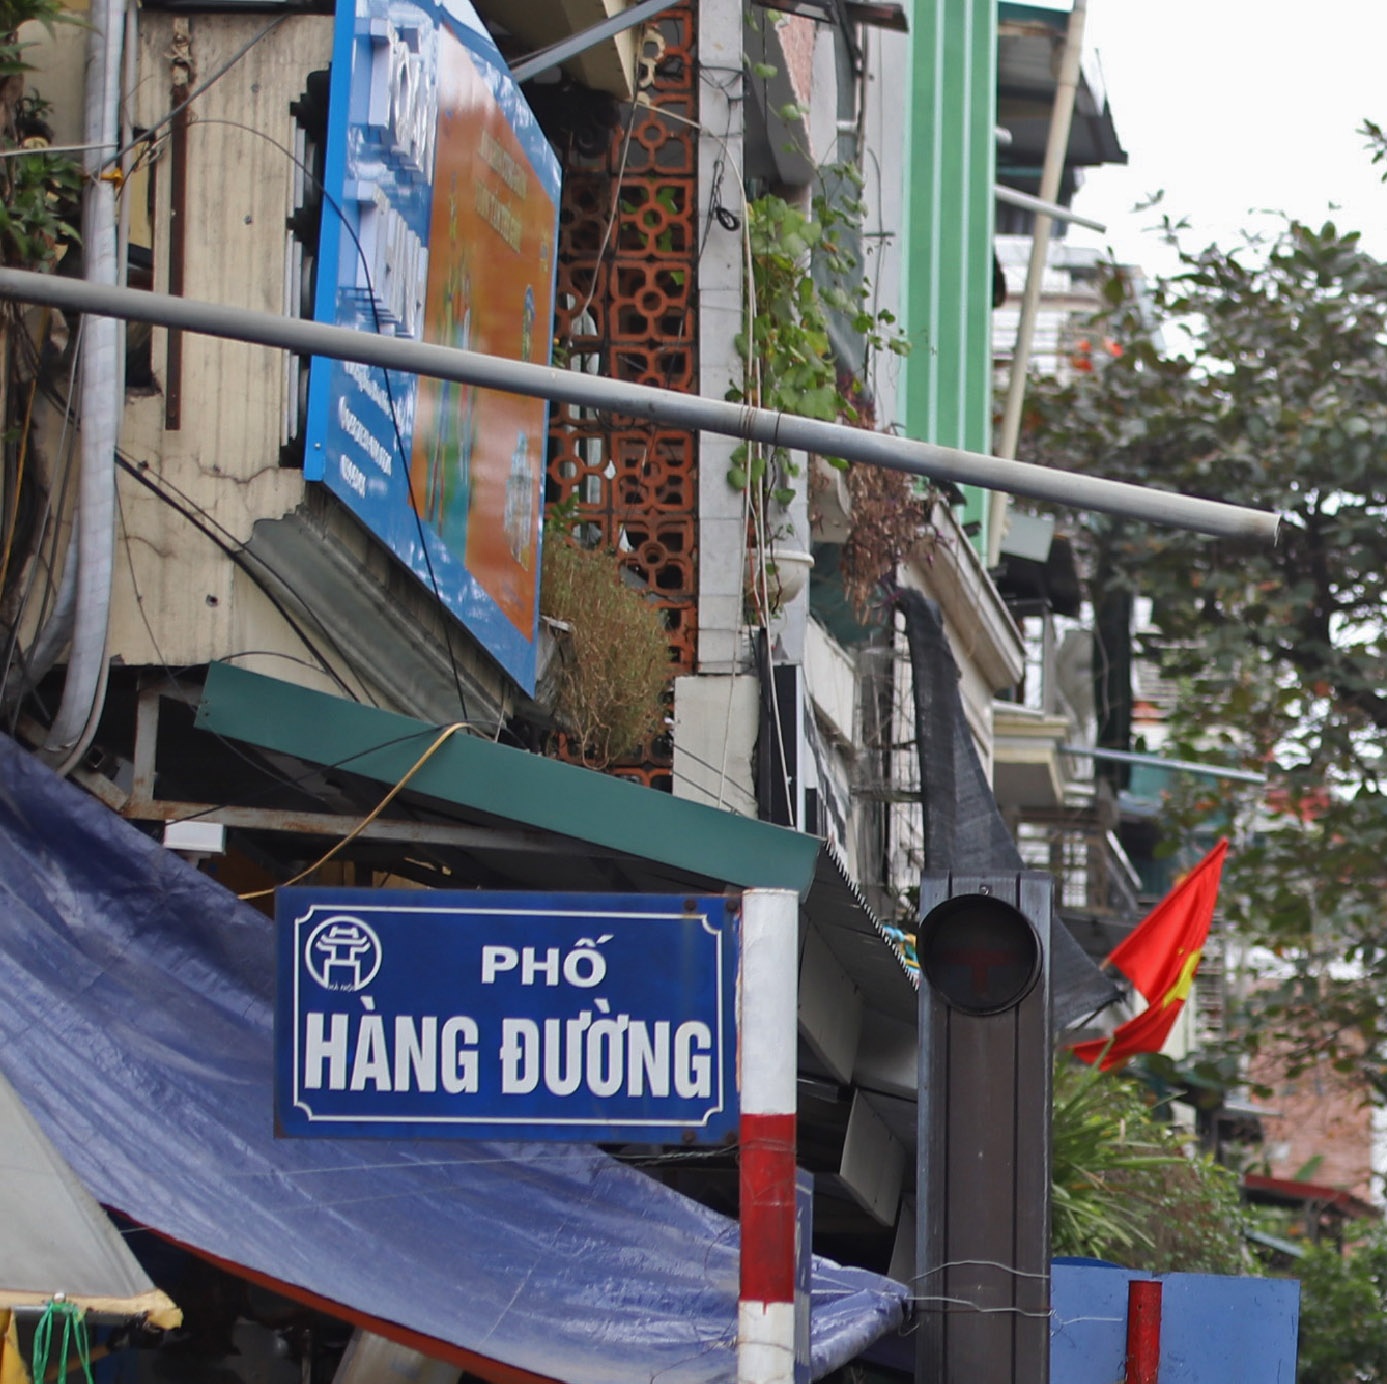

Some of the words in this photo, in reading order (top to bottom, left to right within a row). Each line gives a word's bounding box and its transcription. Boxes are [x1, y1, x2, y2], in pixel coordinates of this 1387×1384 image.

[481, 934, 614, 988] PHỐ
[304, 995, 480, 1094] HÀNG
[499, 998, 712, 1099] ĐƯỜNG
